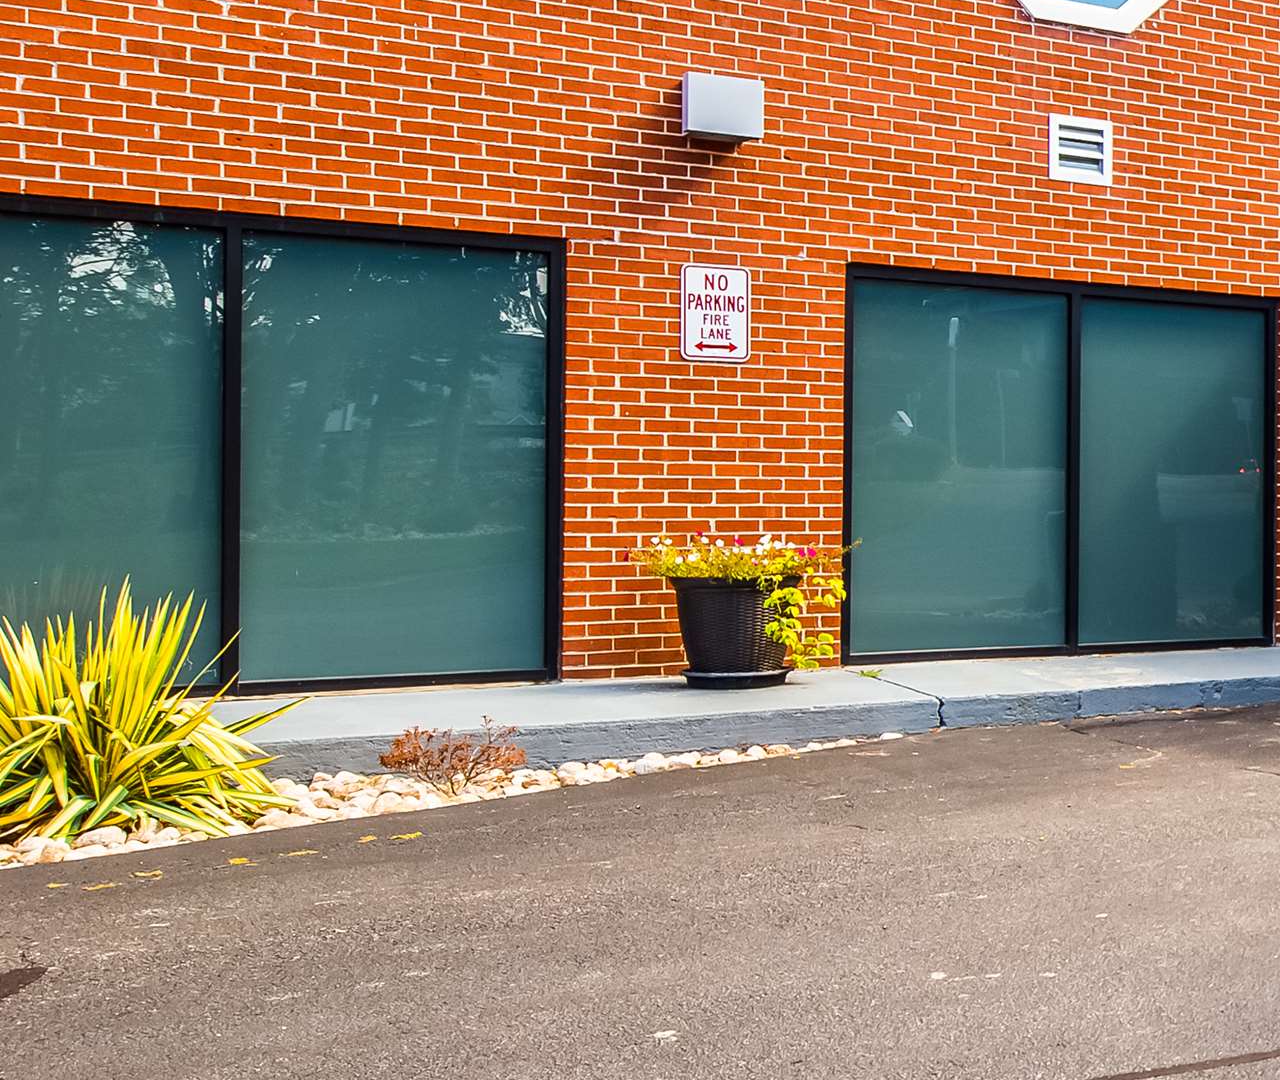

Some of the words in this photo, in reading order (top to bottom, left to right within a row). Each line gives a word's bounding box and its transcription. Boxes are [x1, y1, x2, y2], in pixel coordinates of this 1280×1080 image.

[704, 273, 728, 291] NO
[688, 293, 745, 313] PARKING
[703, 314, 730, 326] FIRE
[701, 327, 731, 340] LANE
